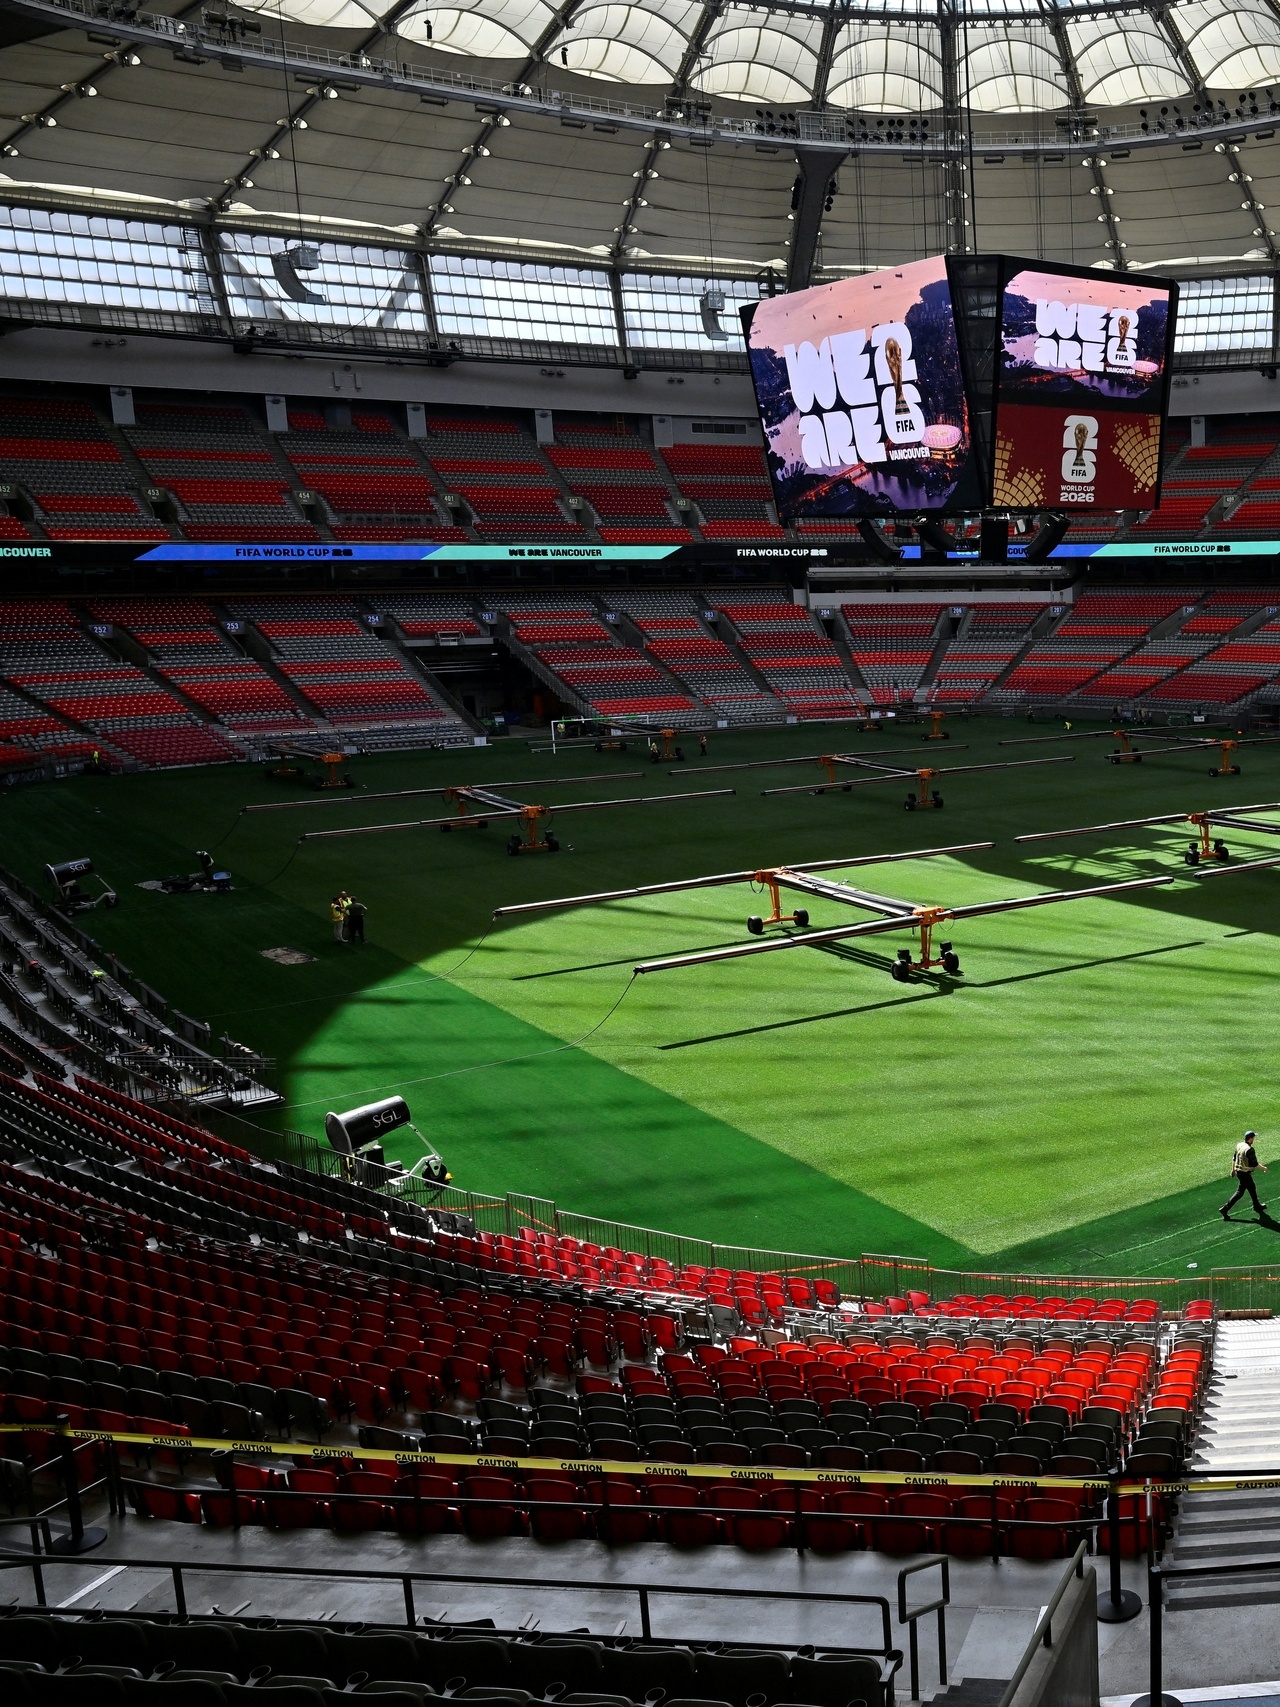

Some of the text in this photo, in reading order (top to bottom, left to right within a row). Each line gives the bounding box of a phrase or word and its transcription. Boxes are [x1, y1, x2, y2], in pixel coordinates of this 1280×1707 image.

[1036, 298, 1107, 343] WE
[1034, 337, 1106, 372] ARE
[783, 328, 878, 413] WE
[896, 419, 915, 433] FIFA
[799, 405, 887, 468] ARE
[889, 447, 930, 460] VANCOUVER
[1060, 492, 1094, 502] 2026
[235, 548, 261, 556] FIFA
[263, 548, 305, 556] WORLD
[307, 548, 330, 556] CUP
[94, 626, 106, 634] 252
[226, 622, 238, 630] 253
[70, 863, 88, 872] SGL
[372, 1110, 401, 1128] SGL
[73, 1431, 113, 1440] CAUTION
[152, 1437, 192, 1447] CAUTION
[232, 1443, 272, 1452] CAUTION
[312, 1448, 353, 1458] CAUTION
[394, 1453, 436, 1463] CAUTION
[477, 1458, 518, 1468] CAUTION
[560, 1462, 602, 1472] CAUTION
[645, 1466, 687, 1476] CAUTION
[730, 1470, 774, 1479] CAUTION
[817, 1474, 860, 1482] CAUTION
[904, 1477, 948, 1485] CAUTION
[1143, 1484, 1189, 1492] CAUTION
